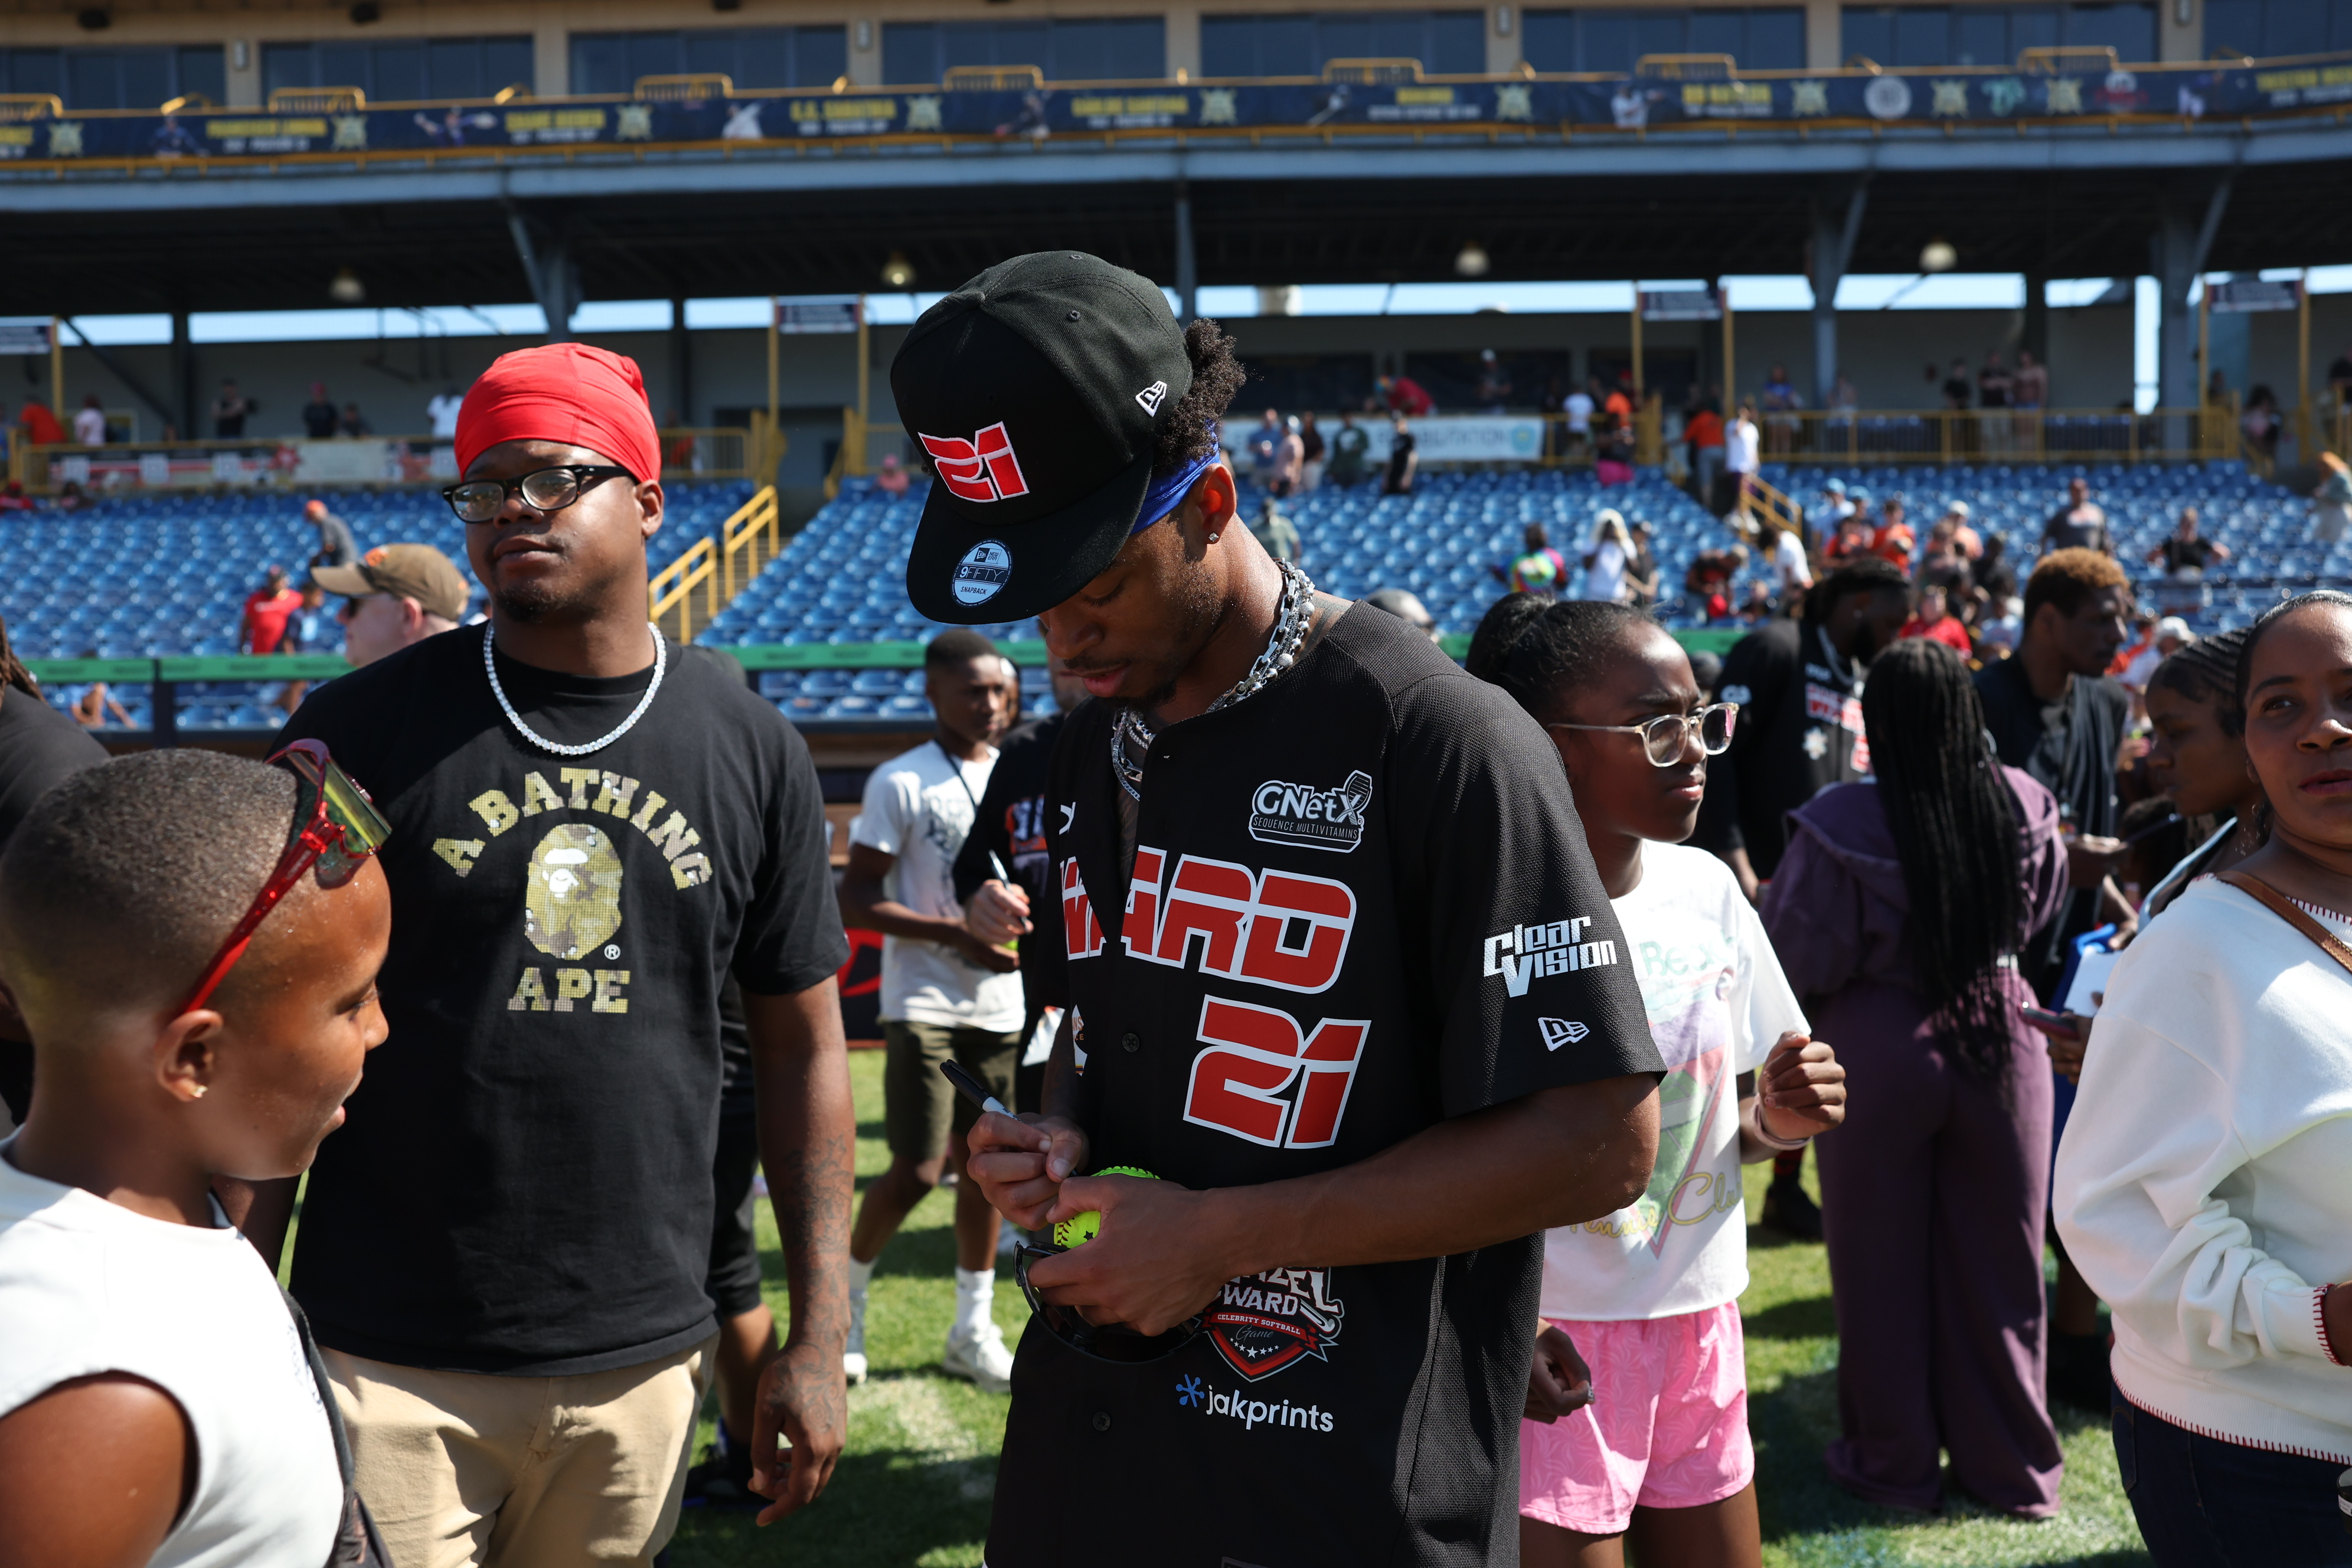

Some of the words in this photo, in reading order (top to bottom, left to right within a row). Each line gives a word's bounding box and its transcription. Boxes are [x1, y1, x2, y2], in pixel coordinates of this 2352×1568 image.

[918, 421, 1030, 502] 21
[959, 566, 1003, 582] 9FIFTY
[961, 586, 987, 595] SNAPBACK
[431, 837, 486, 878] A
[468, 767, 713, 891] BATHING
[1253, 816, 1295, 832] SEQUENCE
[1296, 822, 1358, 839] MULTIVITAMINS
[507, 966, 631, 1014] APE
[1182, 994, 1372, 1149] 21
[1223, 1283, 1299, 1317] WARD
[1217, 1314, 1259, 1324] CELEBRITY
[1261, 1319, 1301, 1335] SOFTBALL
[1236, 1324, 1274, 1343] Game
[1206, 1384, 1334, 1432] jakprints
